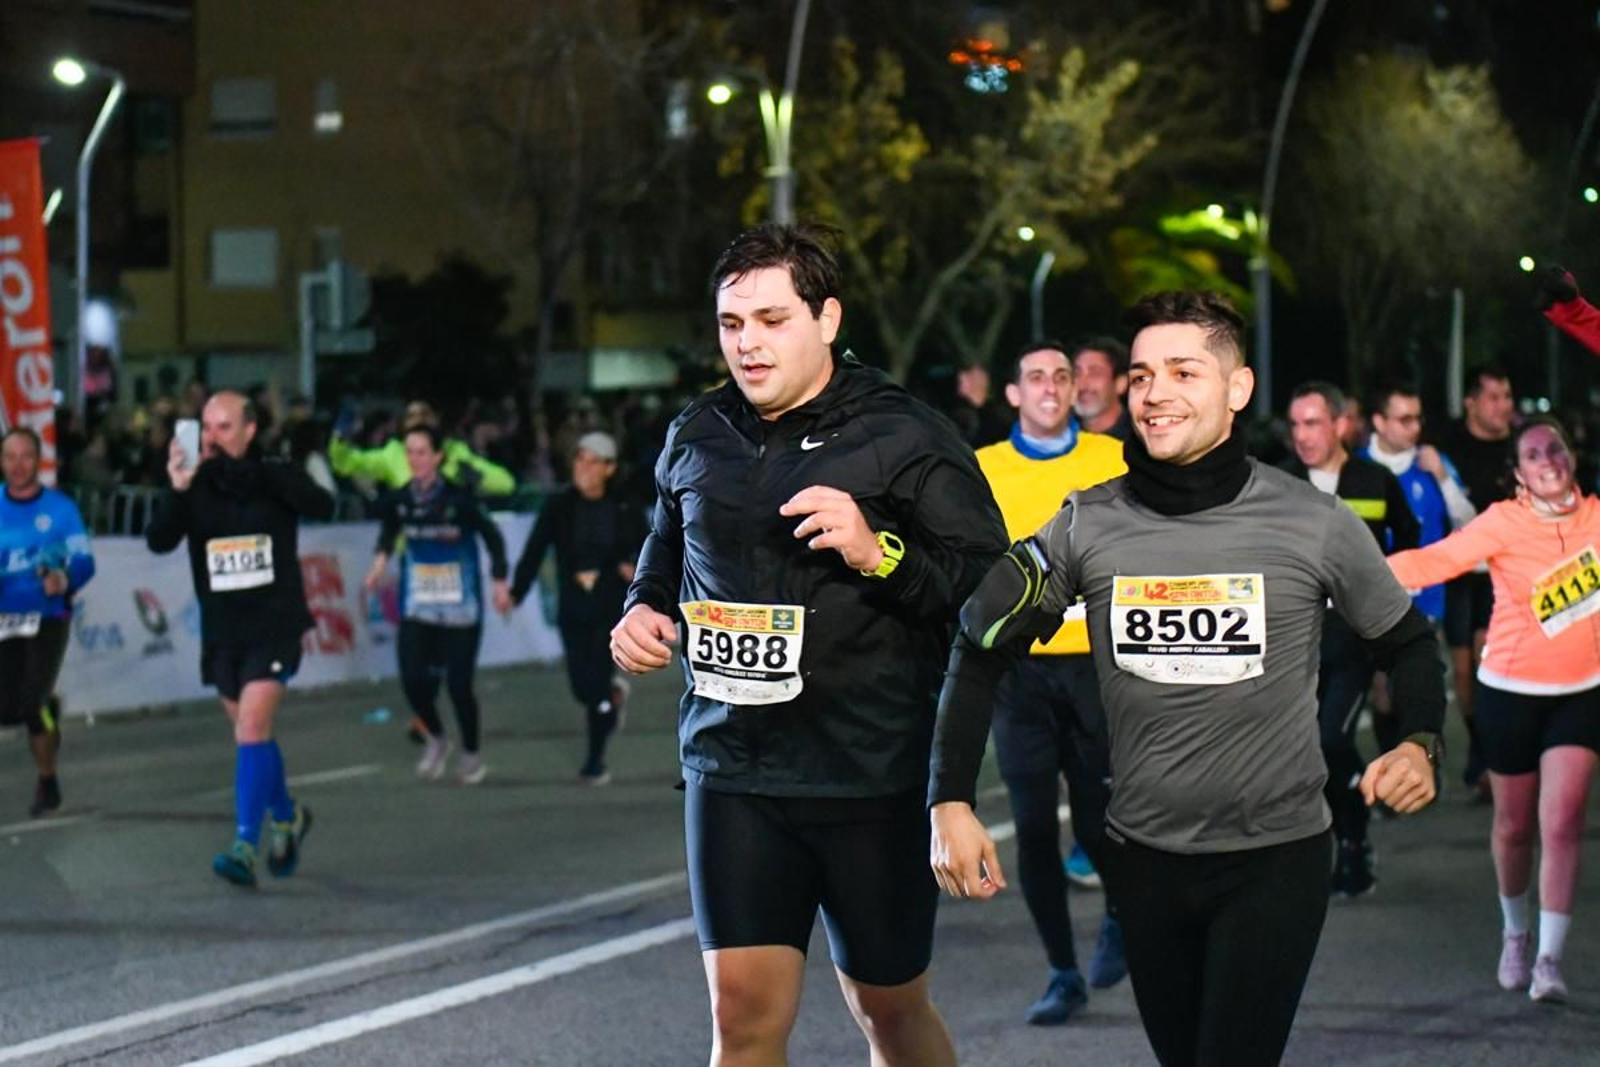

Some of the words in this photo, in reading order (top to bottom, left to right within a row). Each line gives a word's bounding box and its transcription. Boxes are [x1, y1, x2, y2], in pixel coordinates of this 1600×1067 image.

[1144, 582, 1169, 600] 42
[1540, 567, 1600, 612] 4113
[1125, 607, 1250, 643] 8502
[696, 628, 788, 669] 5988
